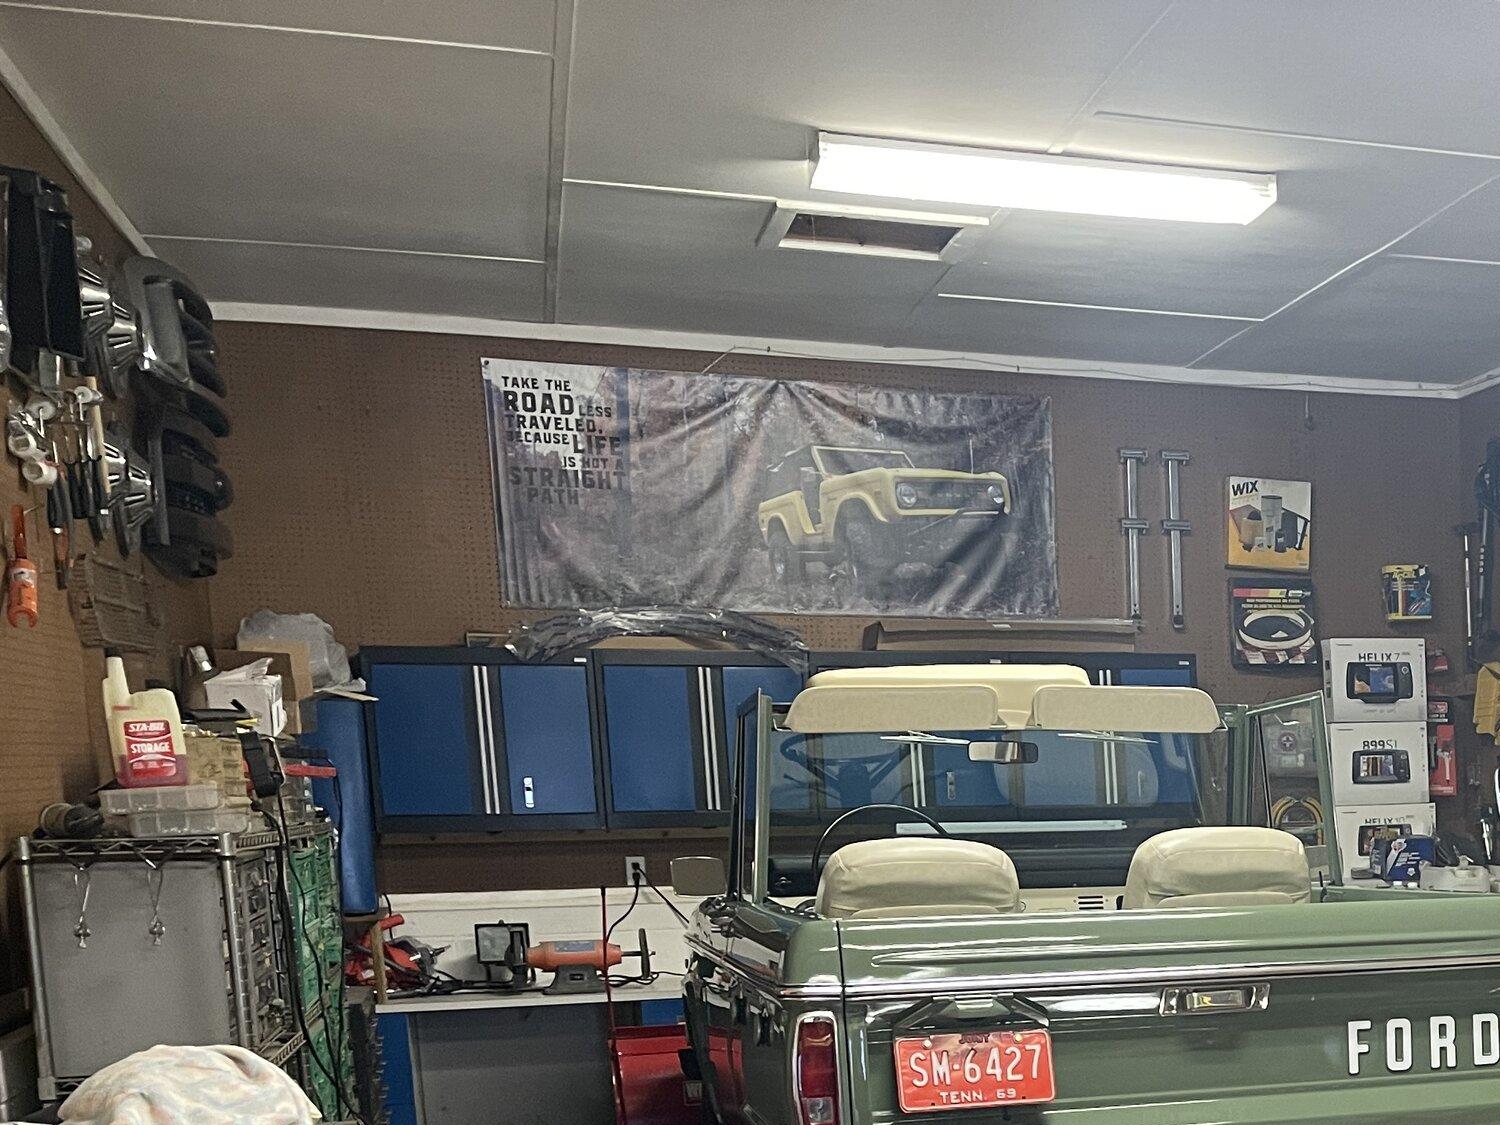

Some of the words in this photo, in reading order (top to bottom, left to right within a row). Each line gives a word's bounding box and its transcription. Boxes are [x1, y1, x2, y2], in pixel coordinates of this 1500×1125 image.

[501, 376, 539, 389] TAKE
[545, 379, 571, 391] THE
[503, 391, 574, 415] ROAD
[578, 405, 612, 417] LESS
[505, 431, 570, 444] BECAUSE
[572, 434, 623, 455] LIFE
[563, 456, 577, 468] IS
[583, 458, 609, 469] NOT
[615, 459, 624, 470] A
[509, 466, 627, 489] STRAIGHT
[1231, 480, 1259, 496] WIX
[130, 742, 171, 753] STORAGE
[1347, 1012, 1500, 1076] FORD
[996, 1087, 1017, 1099] 69
